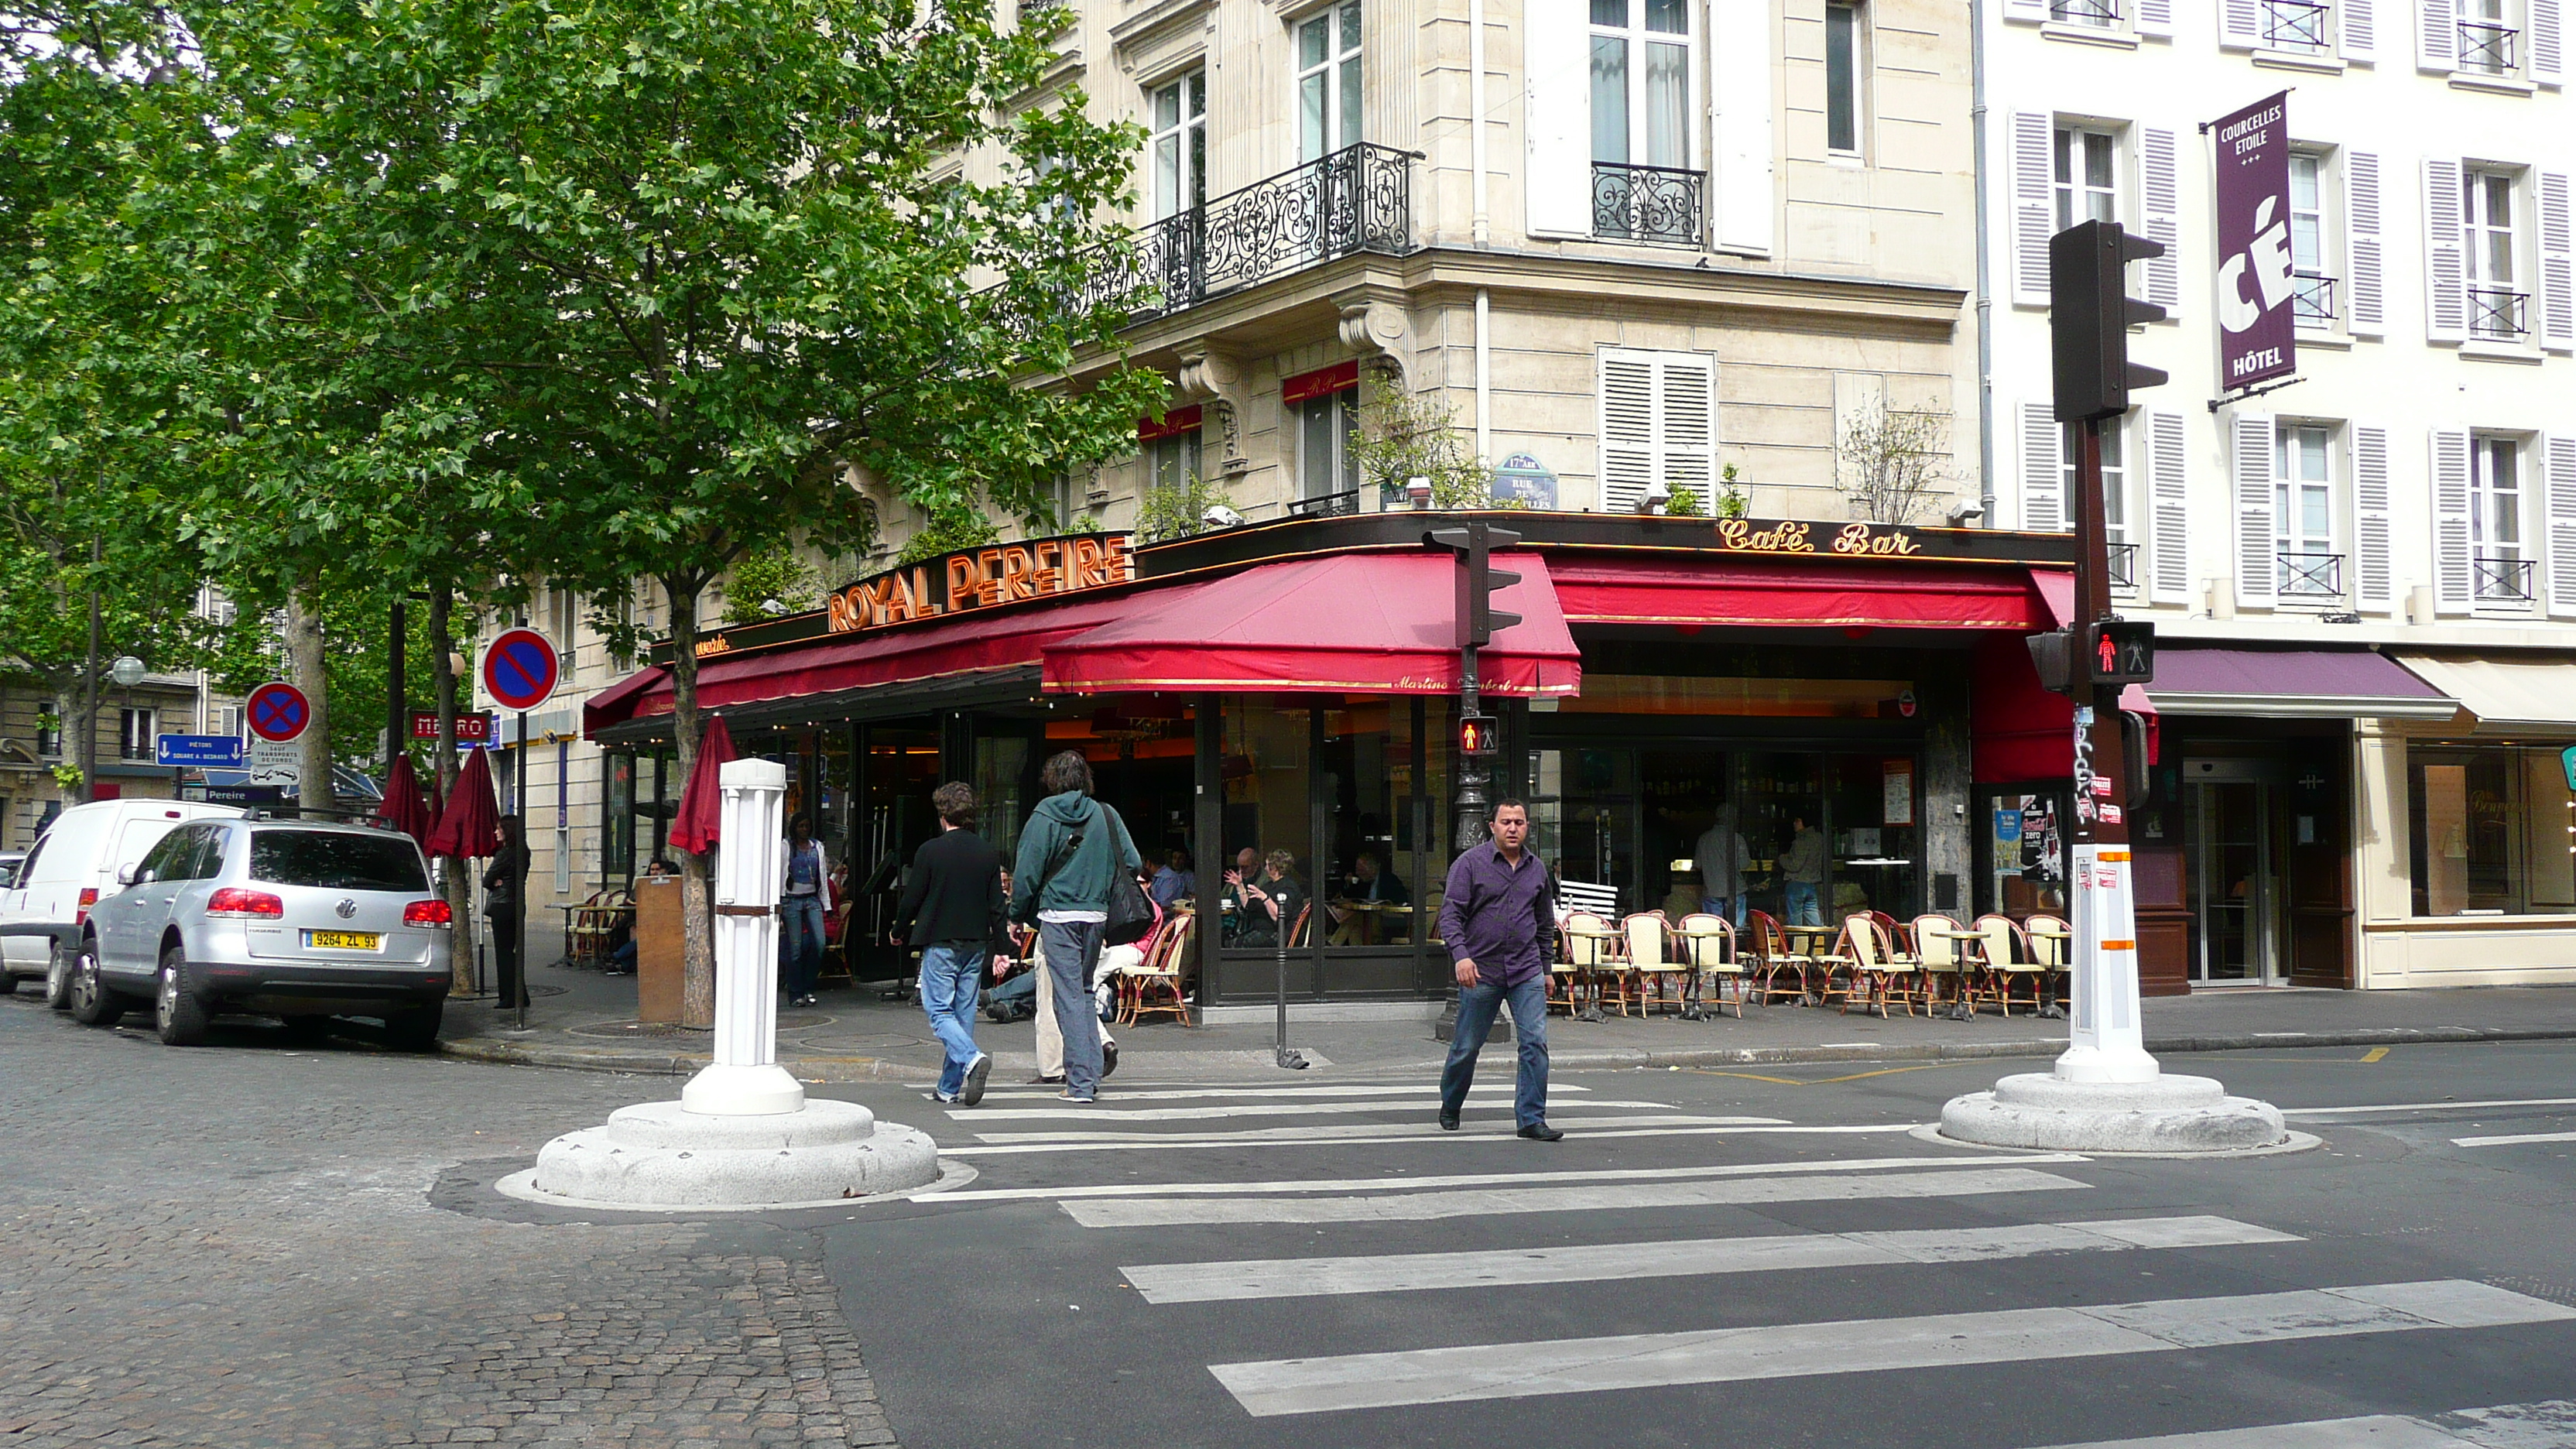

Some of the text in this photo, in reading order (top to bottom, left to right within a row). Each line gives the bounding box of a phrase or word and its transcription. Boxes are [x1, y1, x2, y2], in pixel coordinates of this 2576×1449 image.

[2221, 104, 2281, 142] COURCELLES
[2235, 129, 2267, 155] ETOILE
[2233, 347, 2283, 376] HÔTEL
[1512, 479, 1533, 488] RUE
[1516, 489, 1529, 498] DE
[1719, 519, 1920, 555] Café Bar
[828, 535, 1136, 632] ROYAL PEREIRE
[418, 717, 481, 735] MERO
[209, 790, 245, 800] Pereire
[317, 933, 376, 948] 9264 ZL 93
